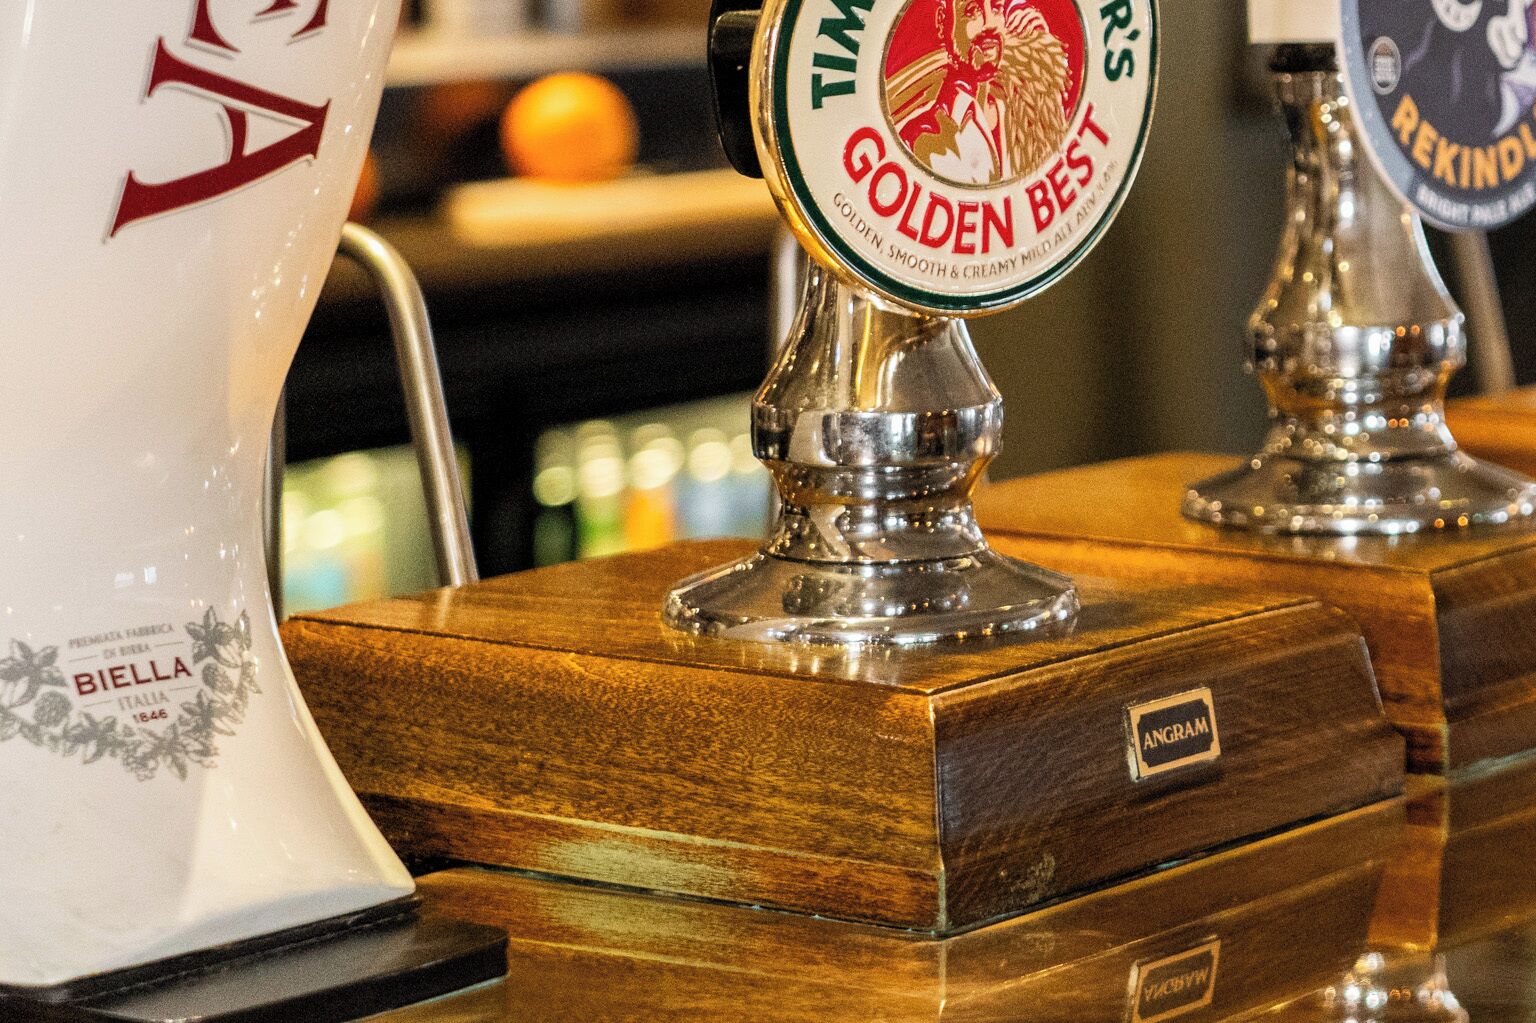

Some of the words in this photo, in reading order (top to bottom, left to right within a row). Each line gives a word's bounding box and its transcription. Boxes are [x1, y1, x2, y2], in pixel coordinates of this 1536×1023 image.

[842, 125, 1015, 255] GOLDEN
[1024, 102, 1112, 234] BEST
[833, 192, 884, 254] GOLDEN,
[887, 244, 947, 277] SMOOTH
[950, 265, 960, 279] &
[962, 256, 1018, 280] CREAMY
[1021, 240, 1052, 266] MILD
[73, 656, 193, 696] BIELLA
[118, 691, 170, 711] ITALIA
[133, 708, 168, 723] 1846
[1143, 716, 1210, 750] ANGRAM
